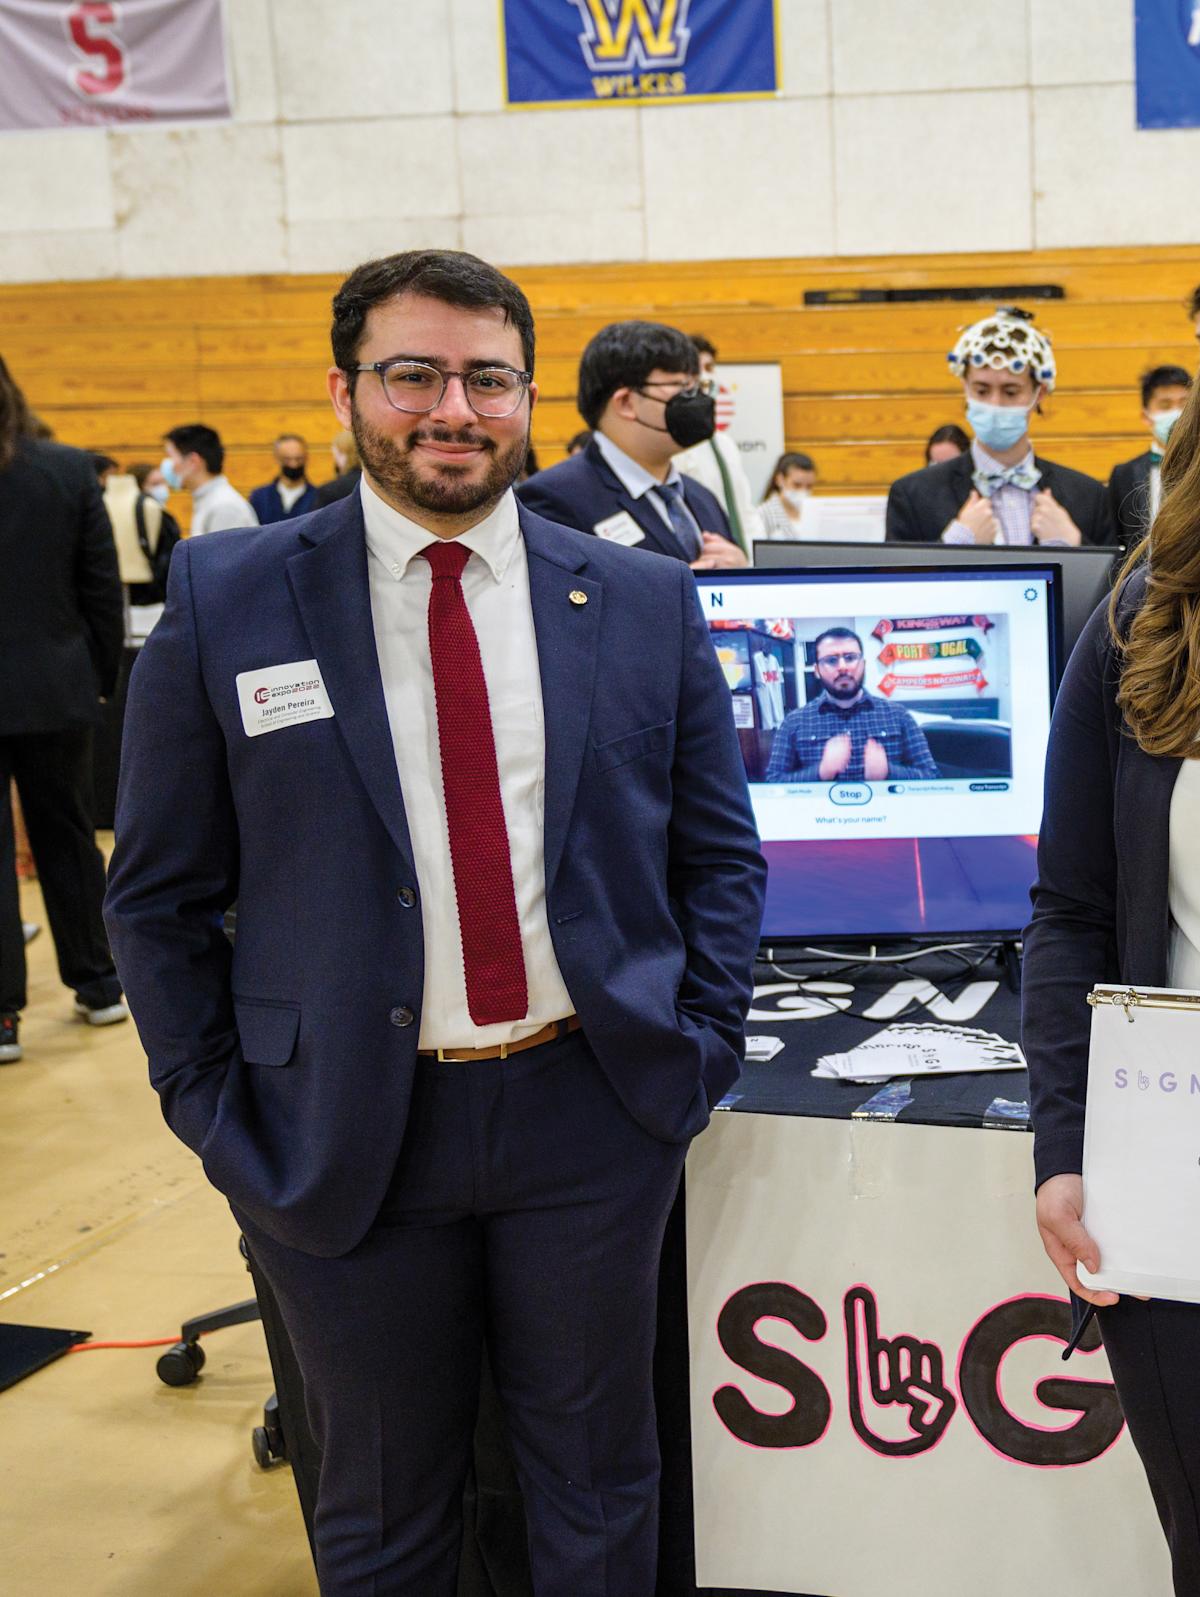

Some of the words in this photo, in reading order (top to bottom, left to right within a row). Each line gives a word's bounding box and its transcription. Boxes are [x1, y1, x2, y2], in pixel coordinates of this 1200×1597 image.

[68, 0, 125, 95] S
[592, 72, 686, 97] WILKES
[271, 680, 320, 692] innovation
[262, 705, 286, 717] Jayden
[287, 699, 315, 710] Pereira
[839, 790, 862, 799] Stop
[861, 815, 887, 824] name?
